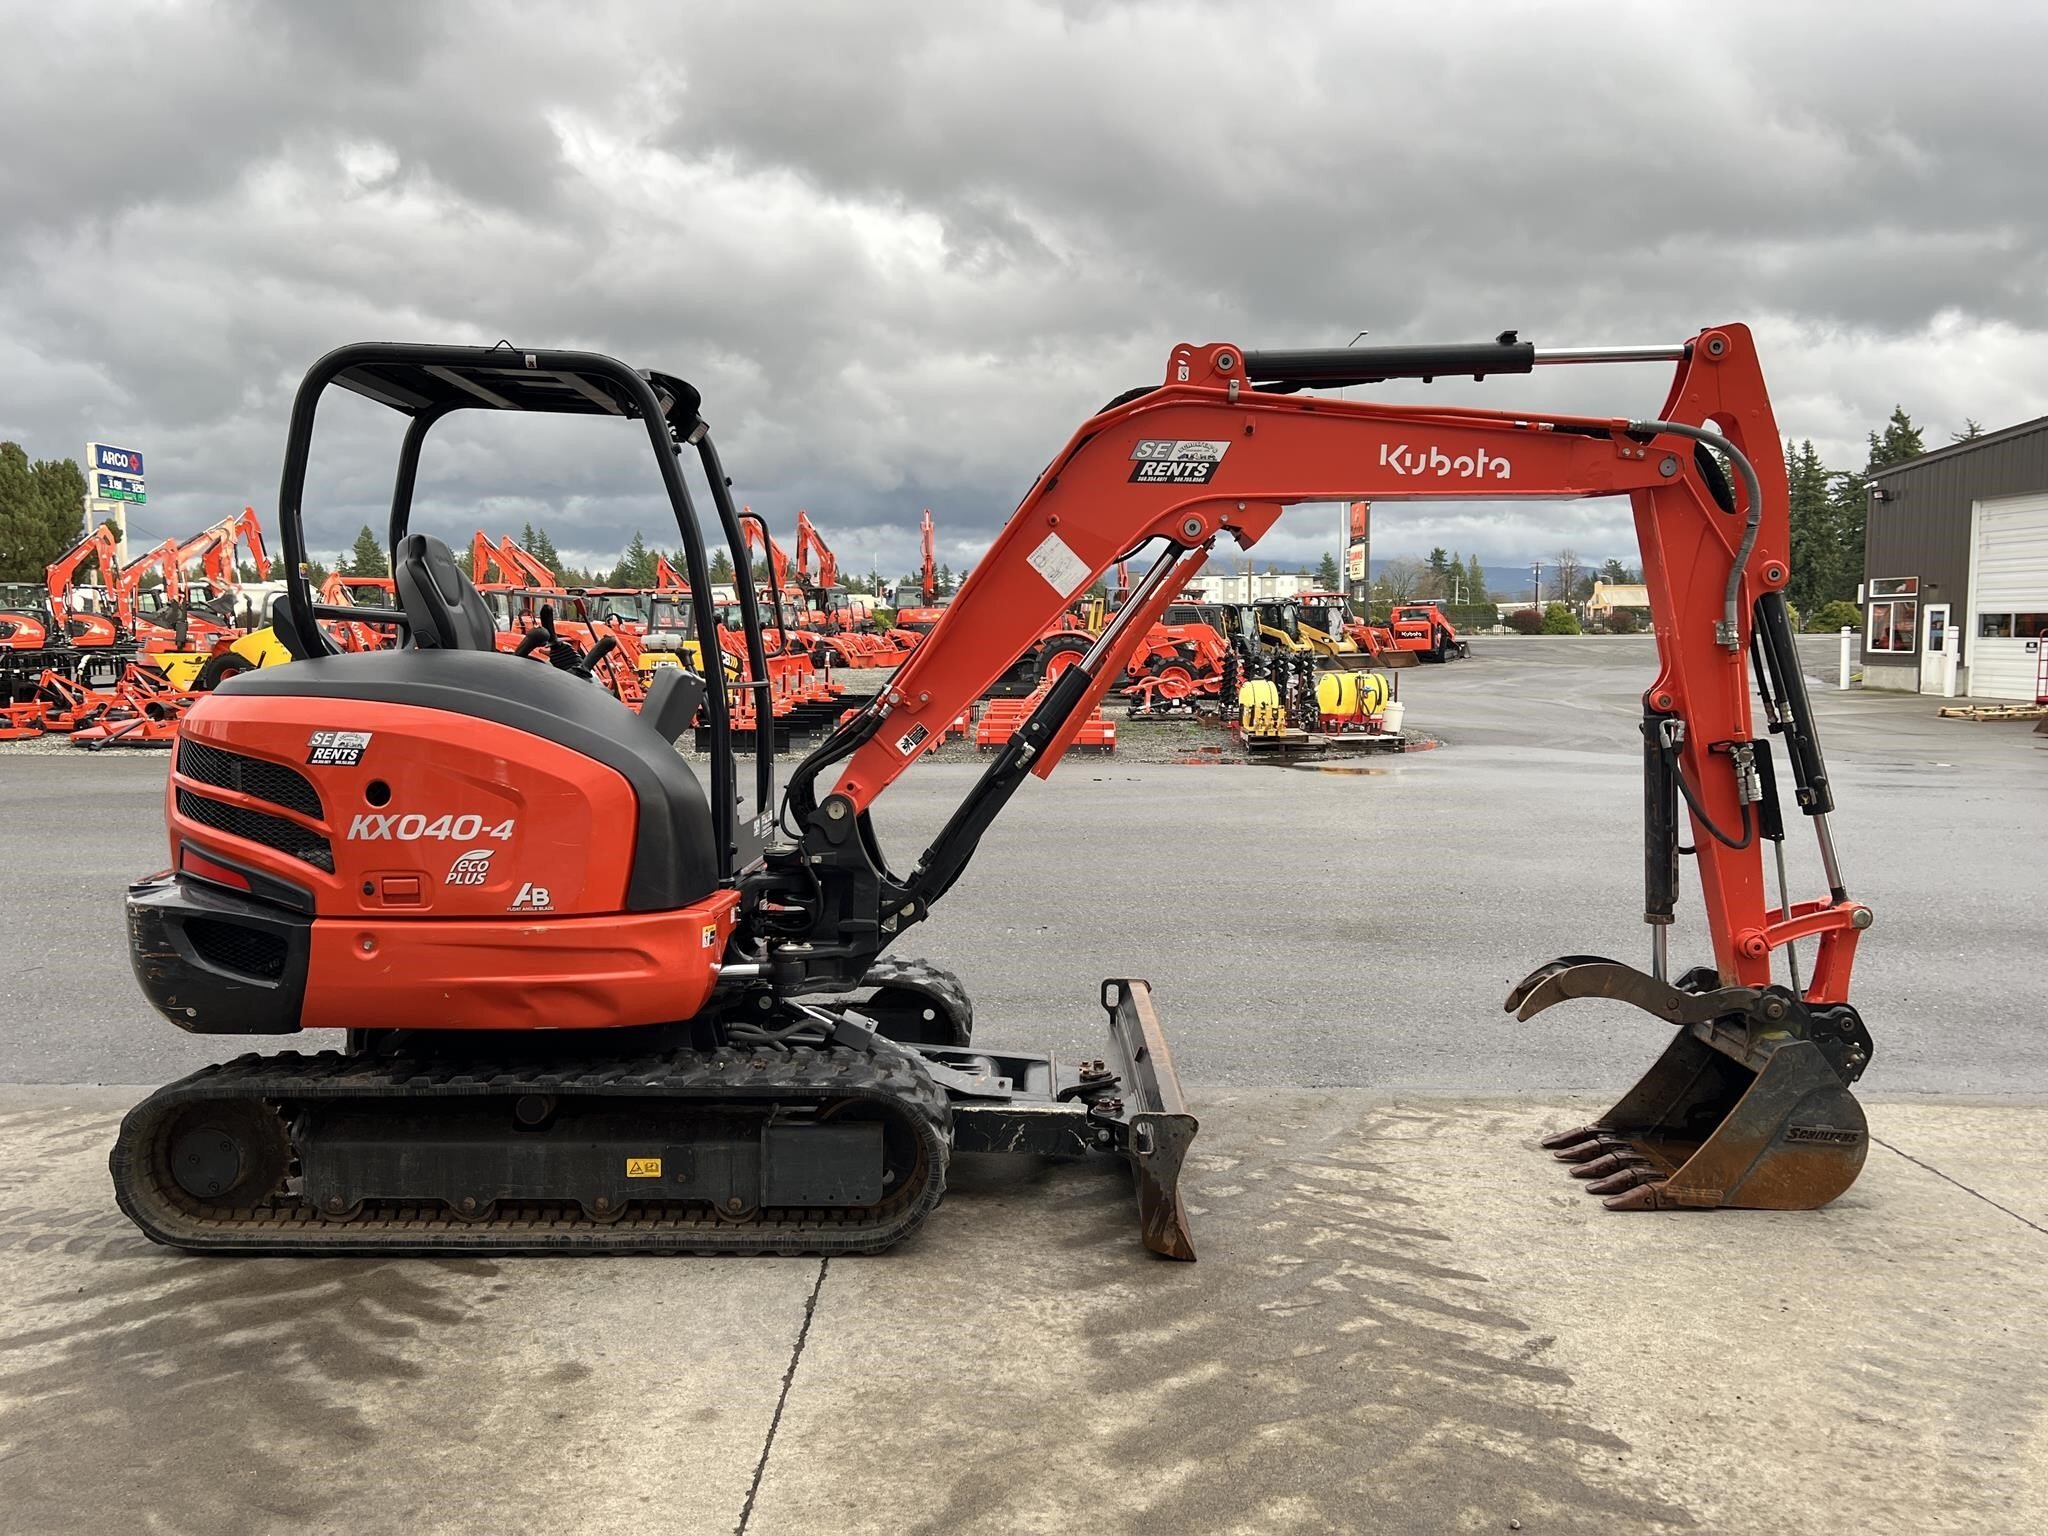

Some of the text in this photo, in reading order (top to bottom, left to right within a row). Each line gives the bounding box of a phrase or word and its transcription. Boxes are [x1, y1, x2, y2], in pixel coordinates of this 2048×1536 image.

[1137, 442, 1171, 458] SE
[102, 450, 129, 468] ARCO
[1380, 444, 1511, 478] Kubota
[1140, 462, 1209, 476] RENTS
[651, 661, 677, 669] JCB
[311, 732, 335, 745] SE
[313, 748, 359, 760] RENTS
[347, 814, 515, 841] KX040-4
[457, 859, 490, 872] eco
[445, 872, 486, 885] PLUS
[512, 882, 550, 906] AB
